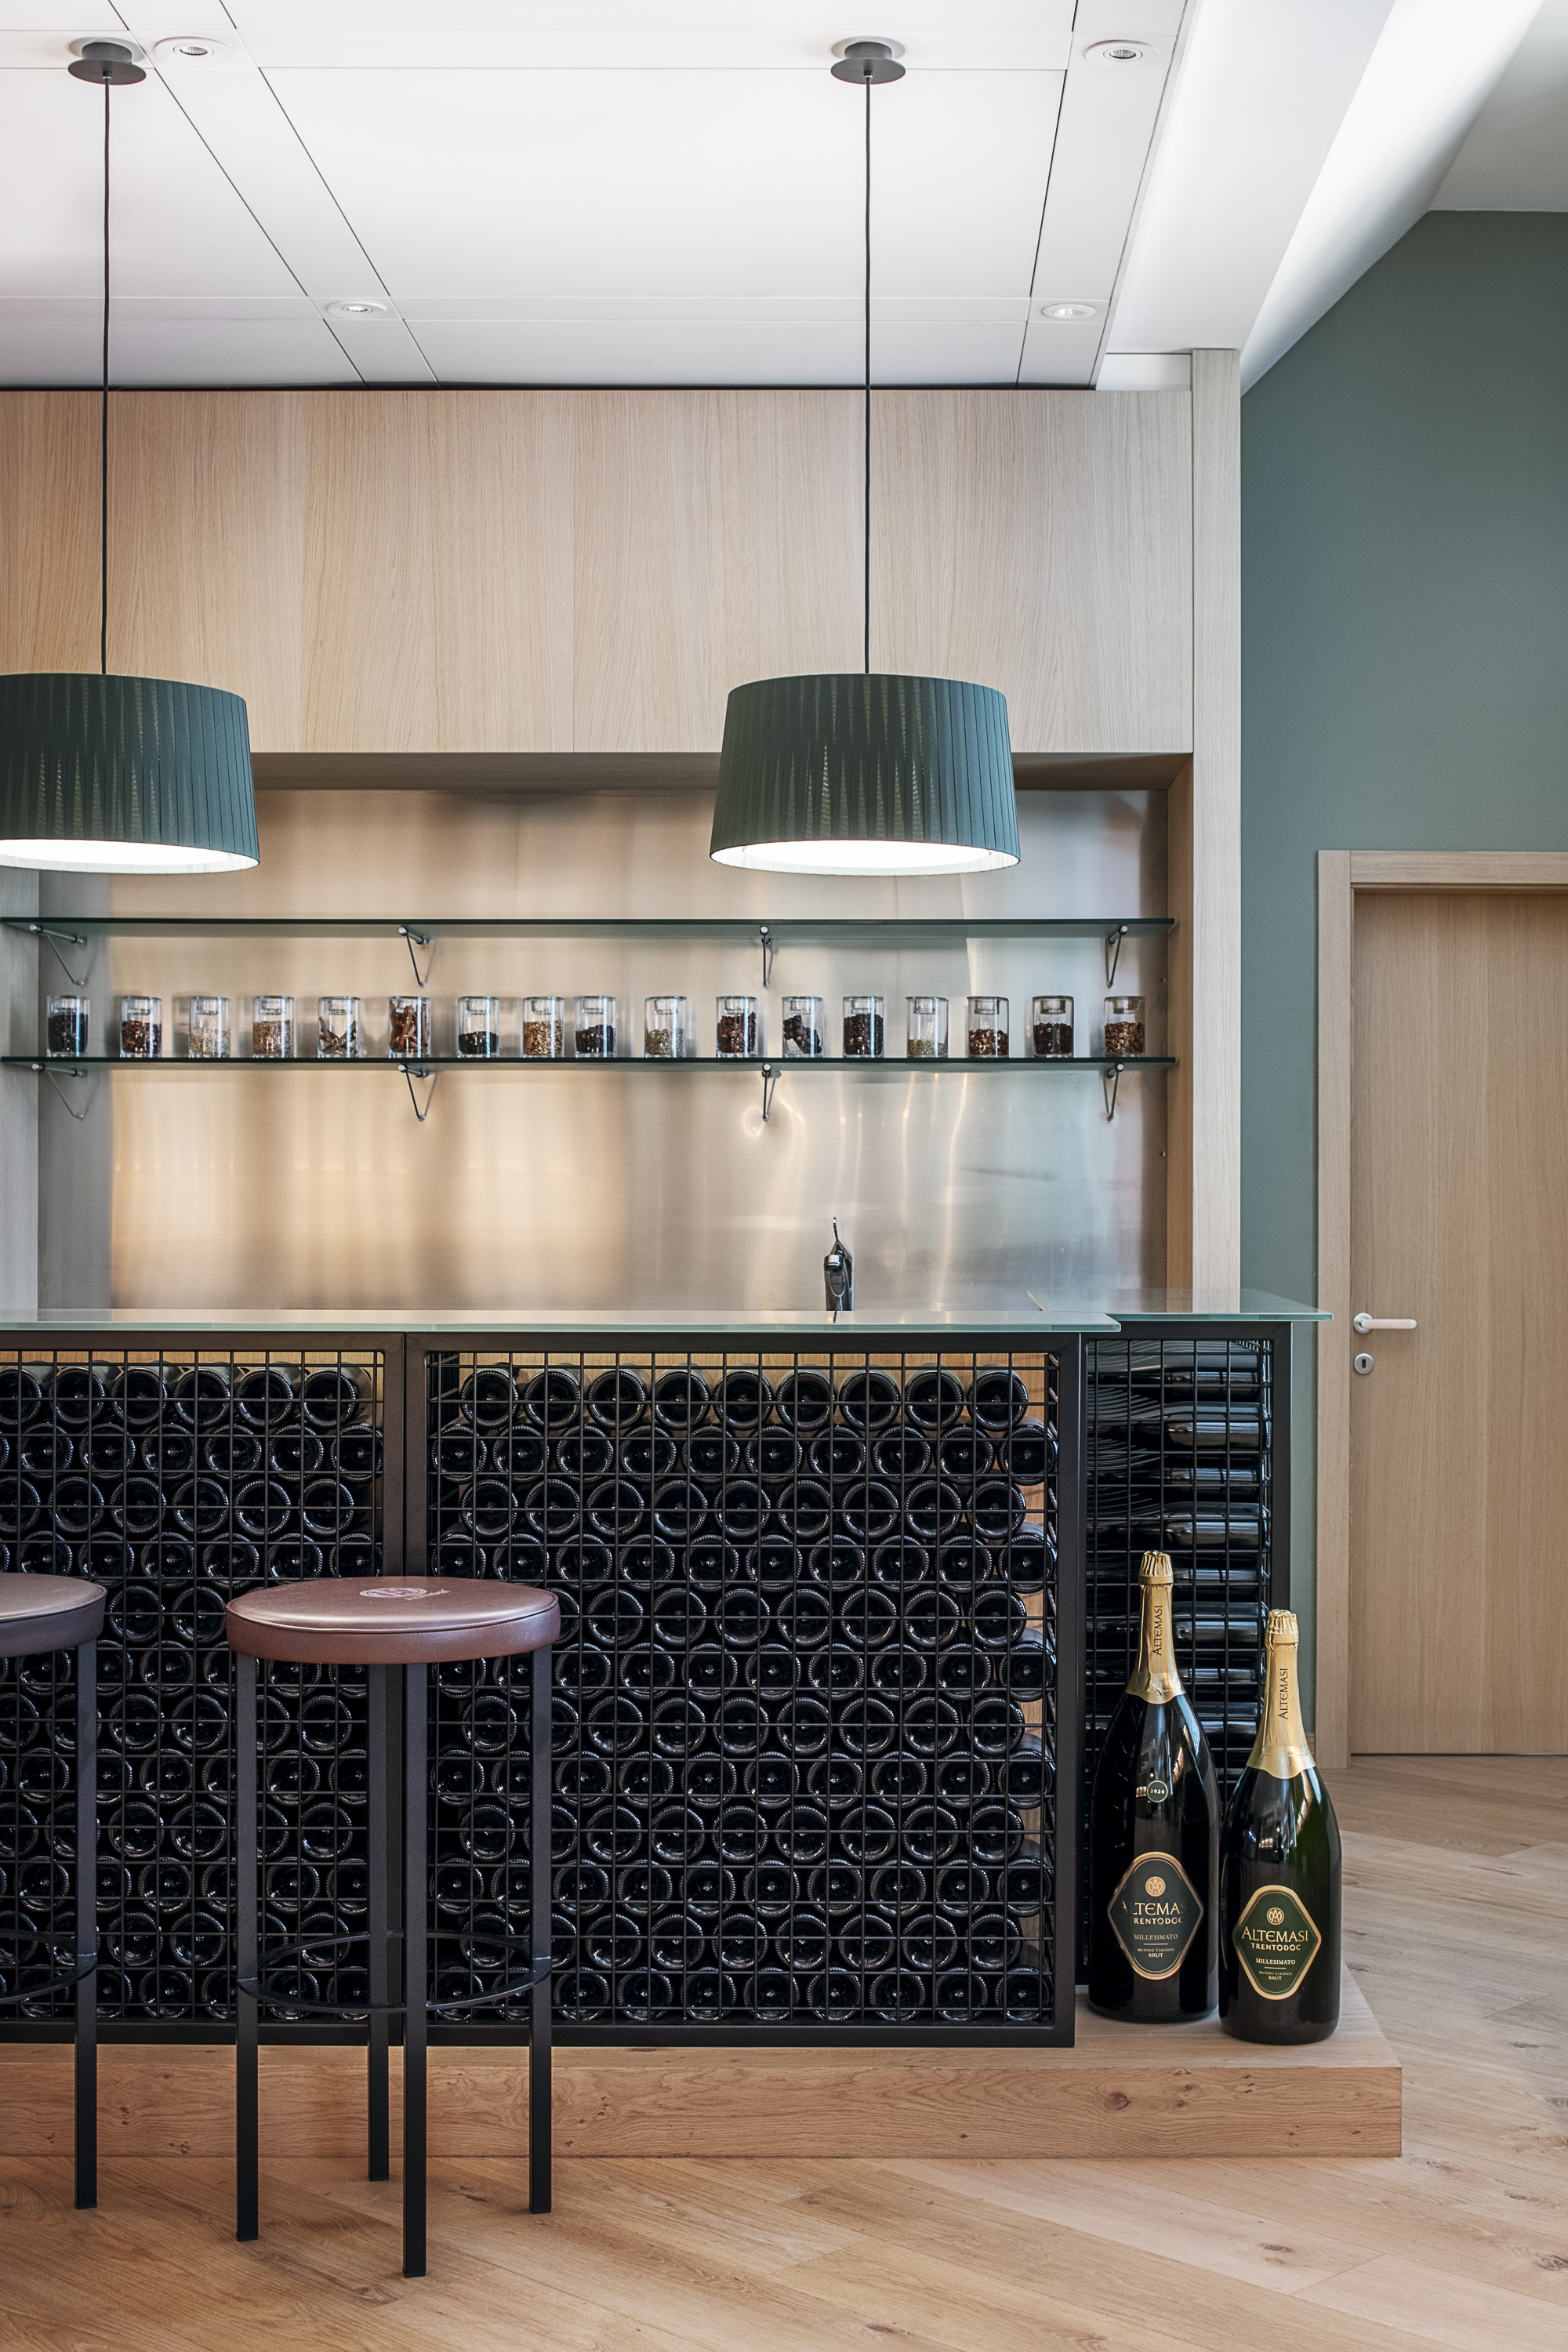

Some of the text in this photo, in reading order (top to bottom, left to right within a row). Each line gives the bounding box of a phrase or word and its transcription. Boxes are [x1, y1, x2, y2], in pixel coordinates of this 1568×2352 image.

[1152, 1605, 1163, 1657] ALTEMASI
[1279, 1668, 1288, 1720] ALTEMASI
[1241, 1926, 1308, 1943] ALTEMASI
[1251, 1943, 1301, 1951] TRENTODOC
